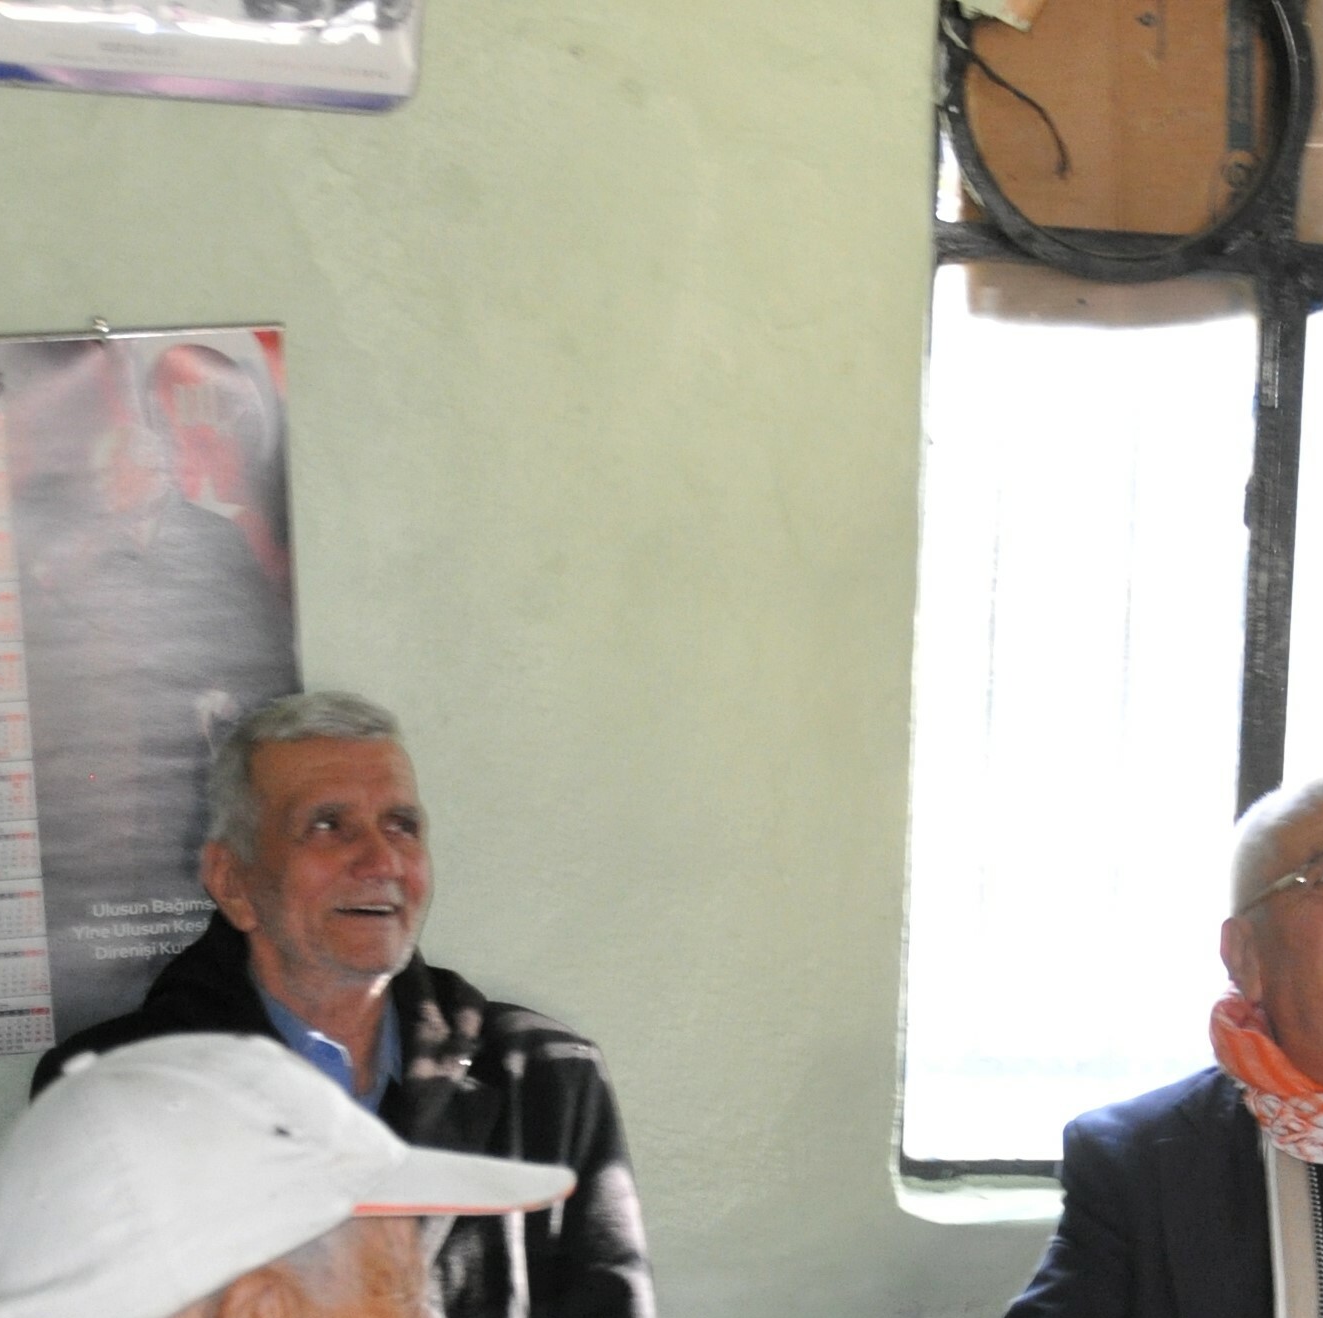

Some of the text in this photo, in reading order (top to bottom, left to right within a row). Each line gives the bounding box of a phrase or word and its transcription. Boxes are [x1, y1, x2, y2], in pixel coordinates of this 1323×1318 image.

[92, 897, 217, 917] Ulusun Bağıms
[72, 918, 210, 939] Yine Ulusun Kesi
[95, 942, 157, 960] Direnişi
